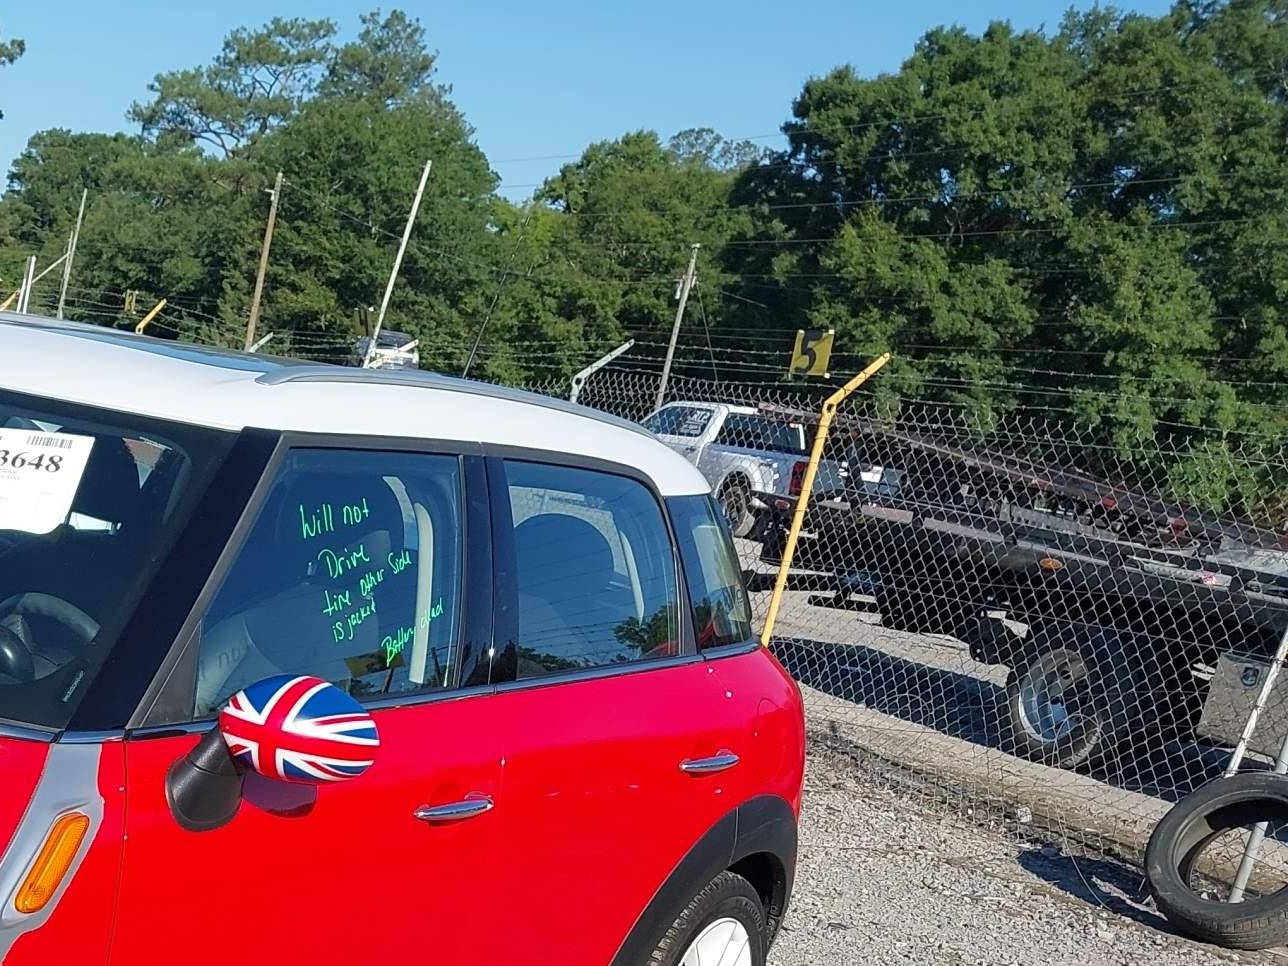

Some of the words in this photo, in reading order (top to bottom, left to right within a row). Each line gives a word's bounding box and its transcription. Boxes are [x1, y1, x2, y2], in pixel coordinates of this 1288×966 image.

[793, 328, 824, 373] 5
[342, 498, 370, 525] not
[317, 544, 370, 579] Drive
